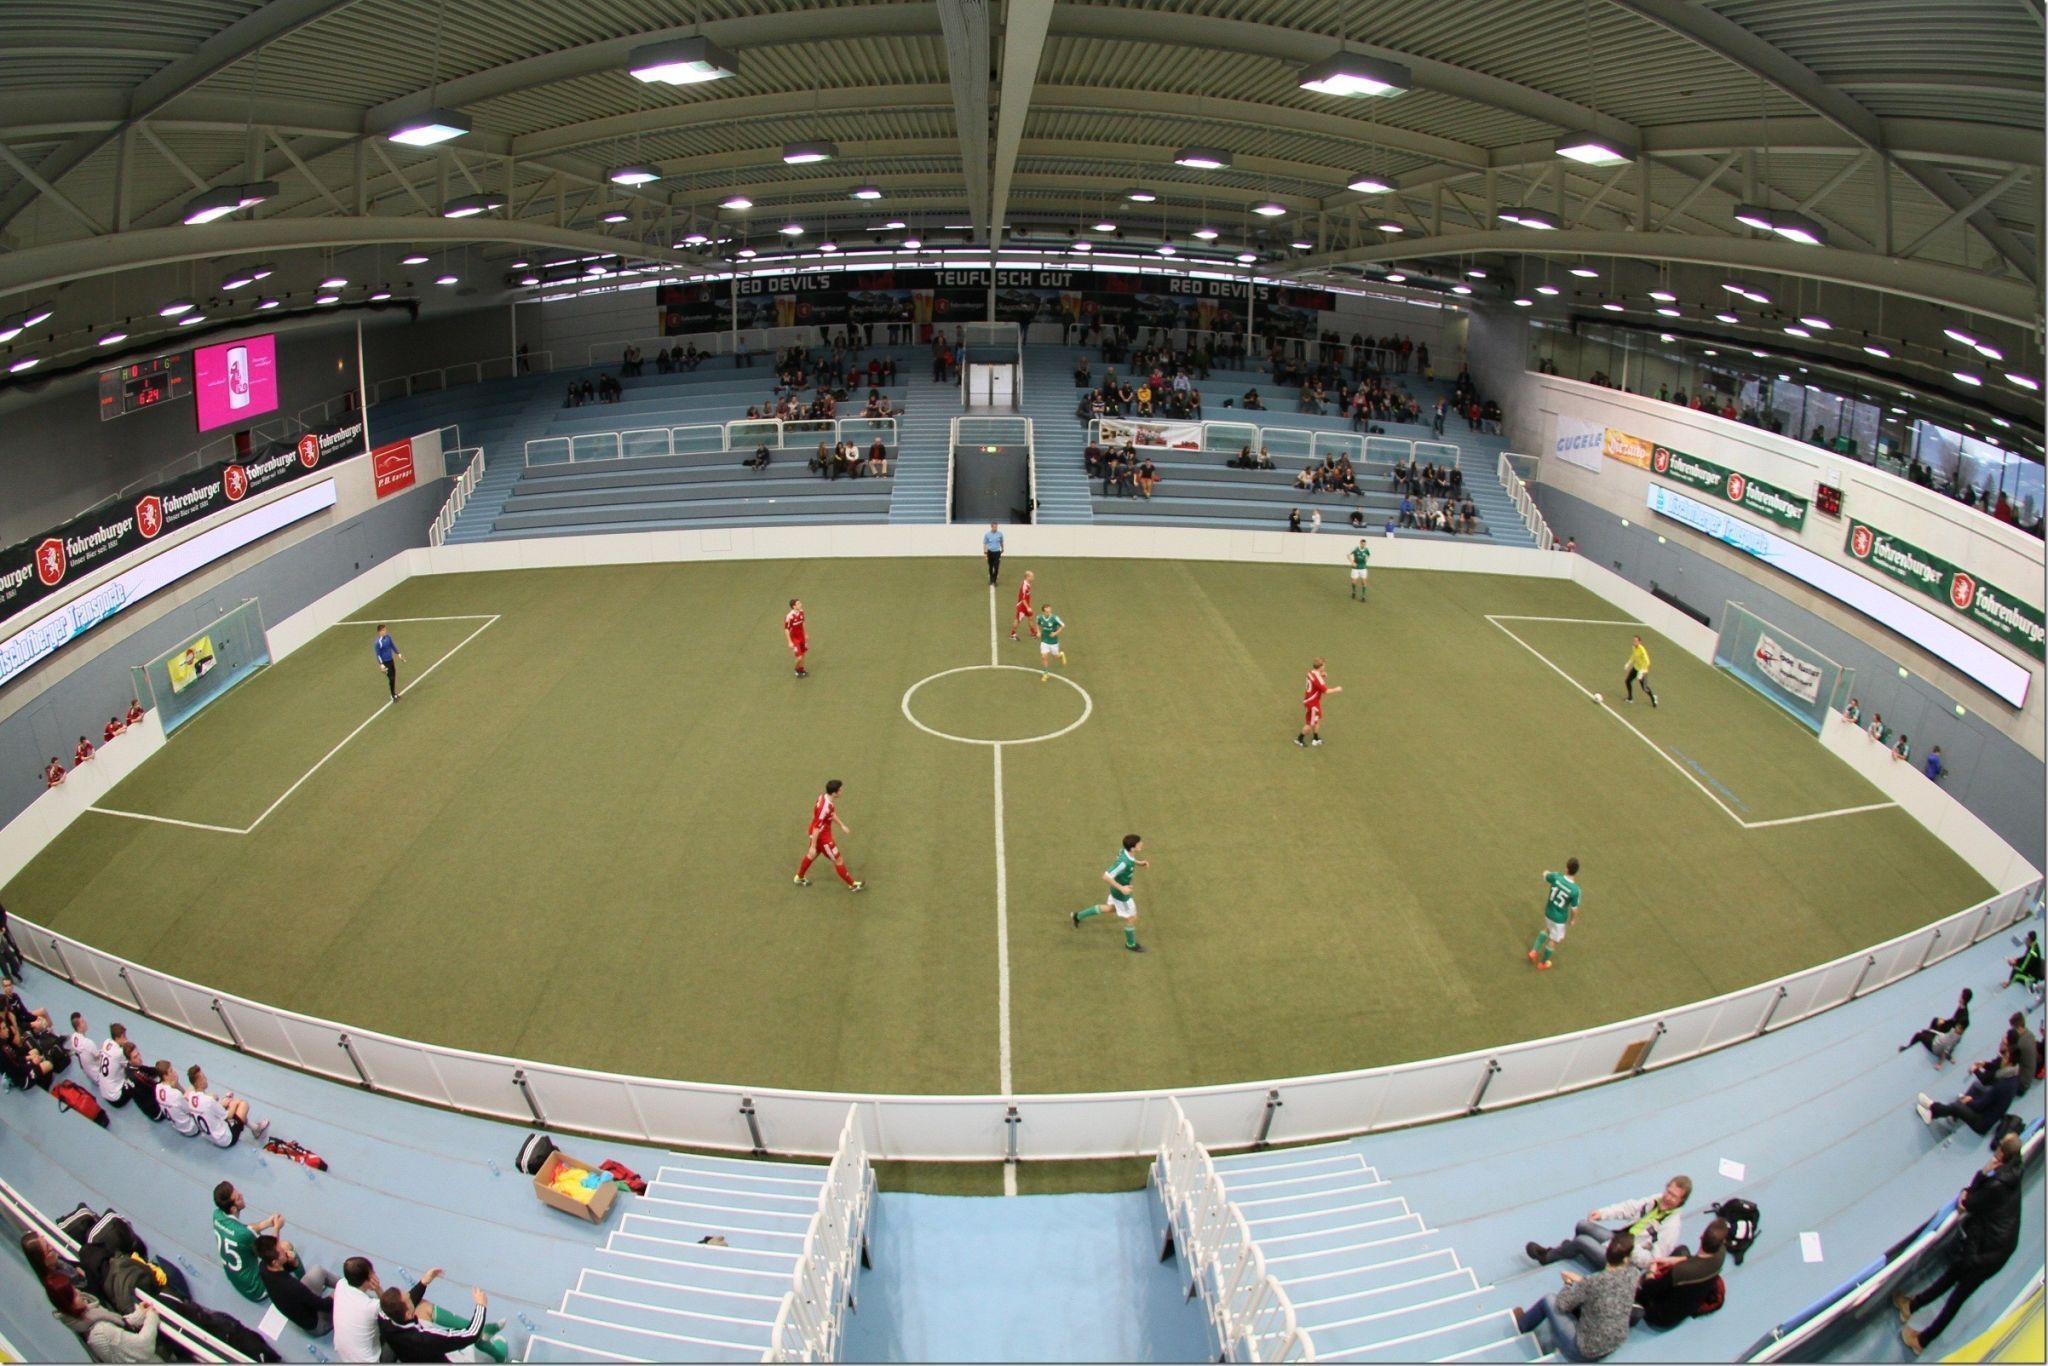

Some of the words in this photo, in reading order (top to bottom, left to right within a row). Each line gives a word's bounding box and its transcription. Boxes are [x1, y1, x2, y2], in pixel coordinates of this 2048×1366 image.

[768, 275, 830, 292] DEVIL'S
[934, 270, 1032, 287] TEUFLSCH
[1039, 272, 1073, 287] GUT
[1170, 278, 1203, 295] RED
[65, 517, 133, 558] fohrenburger
[1976, 586, 2045, 644] fohrenburge
[1550, 886, 1569, 908] 15
